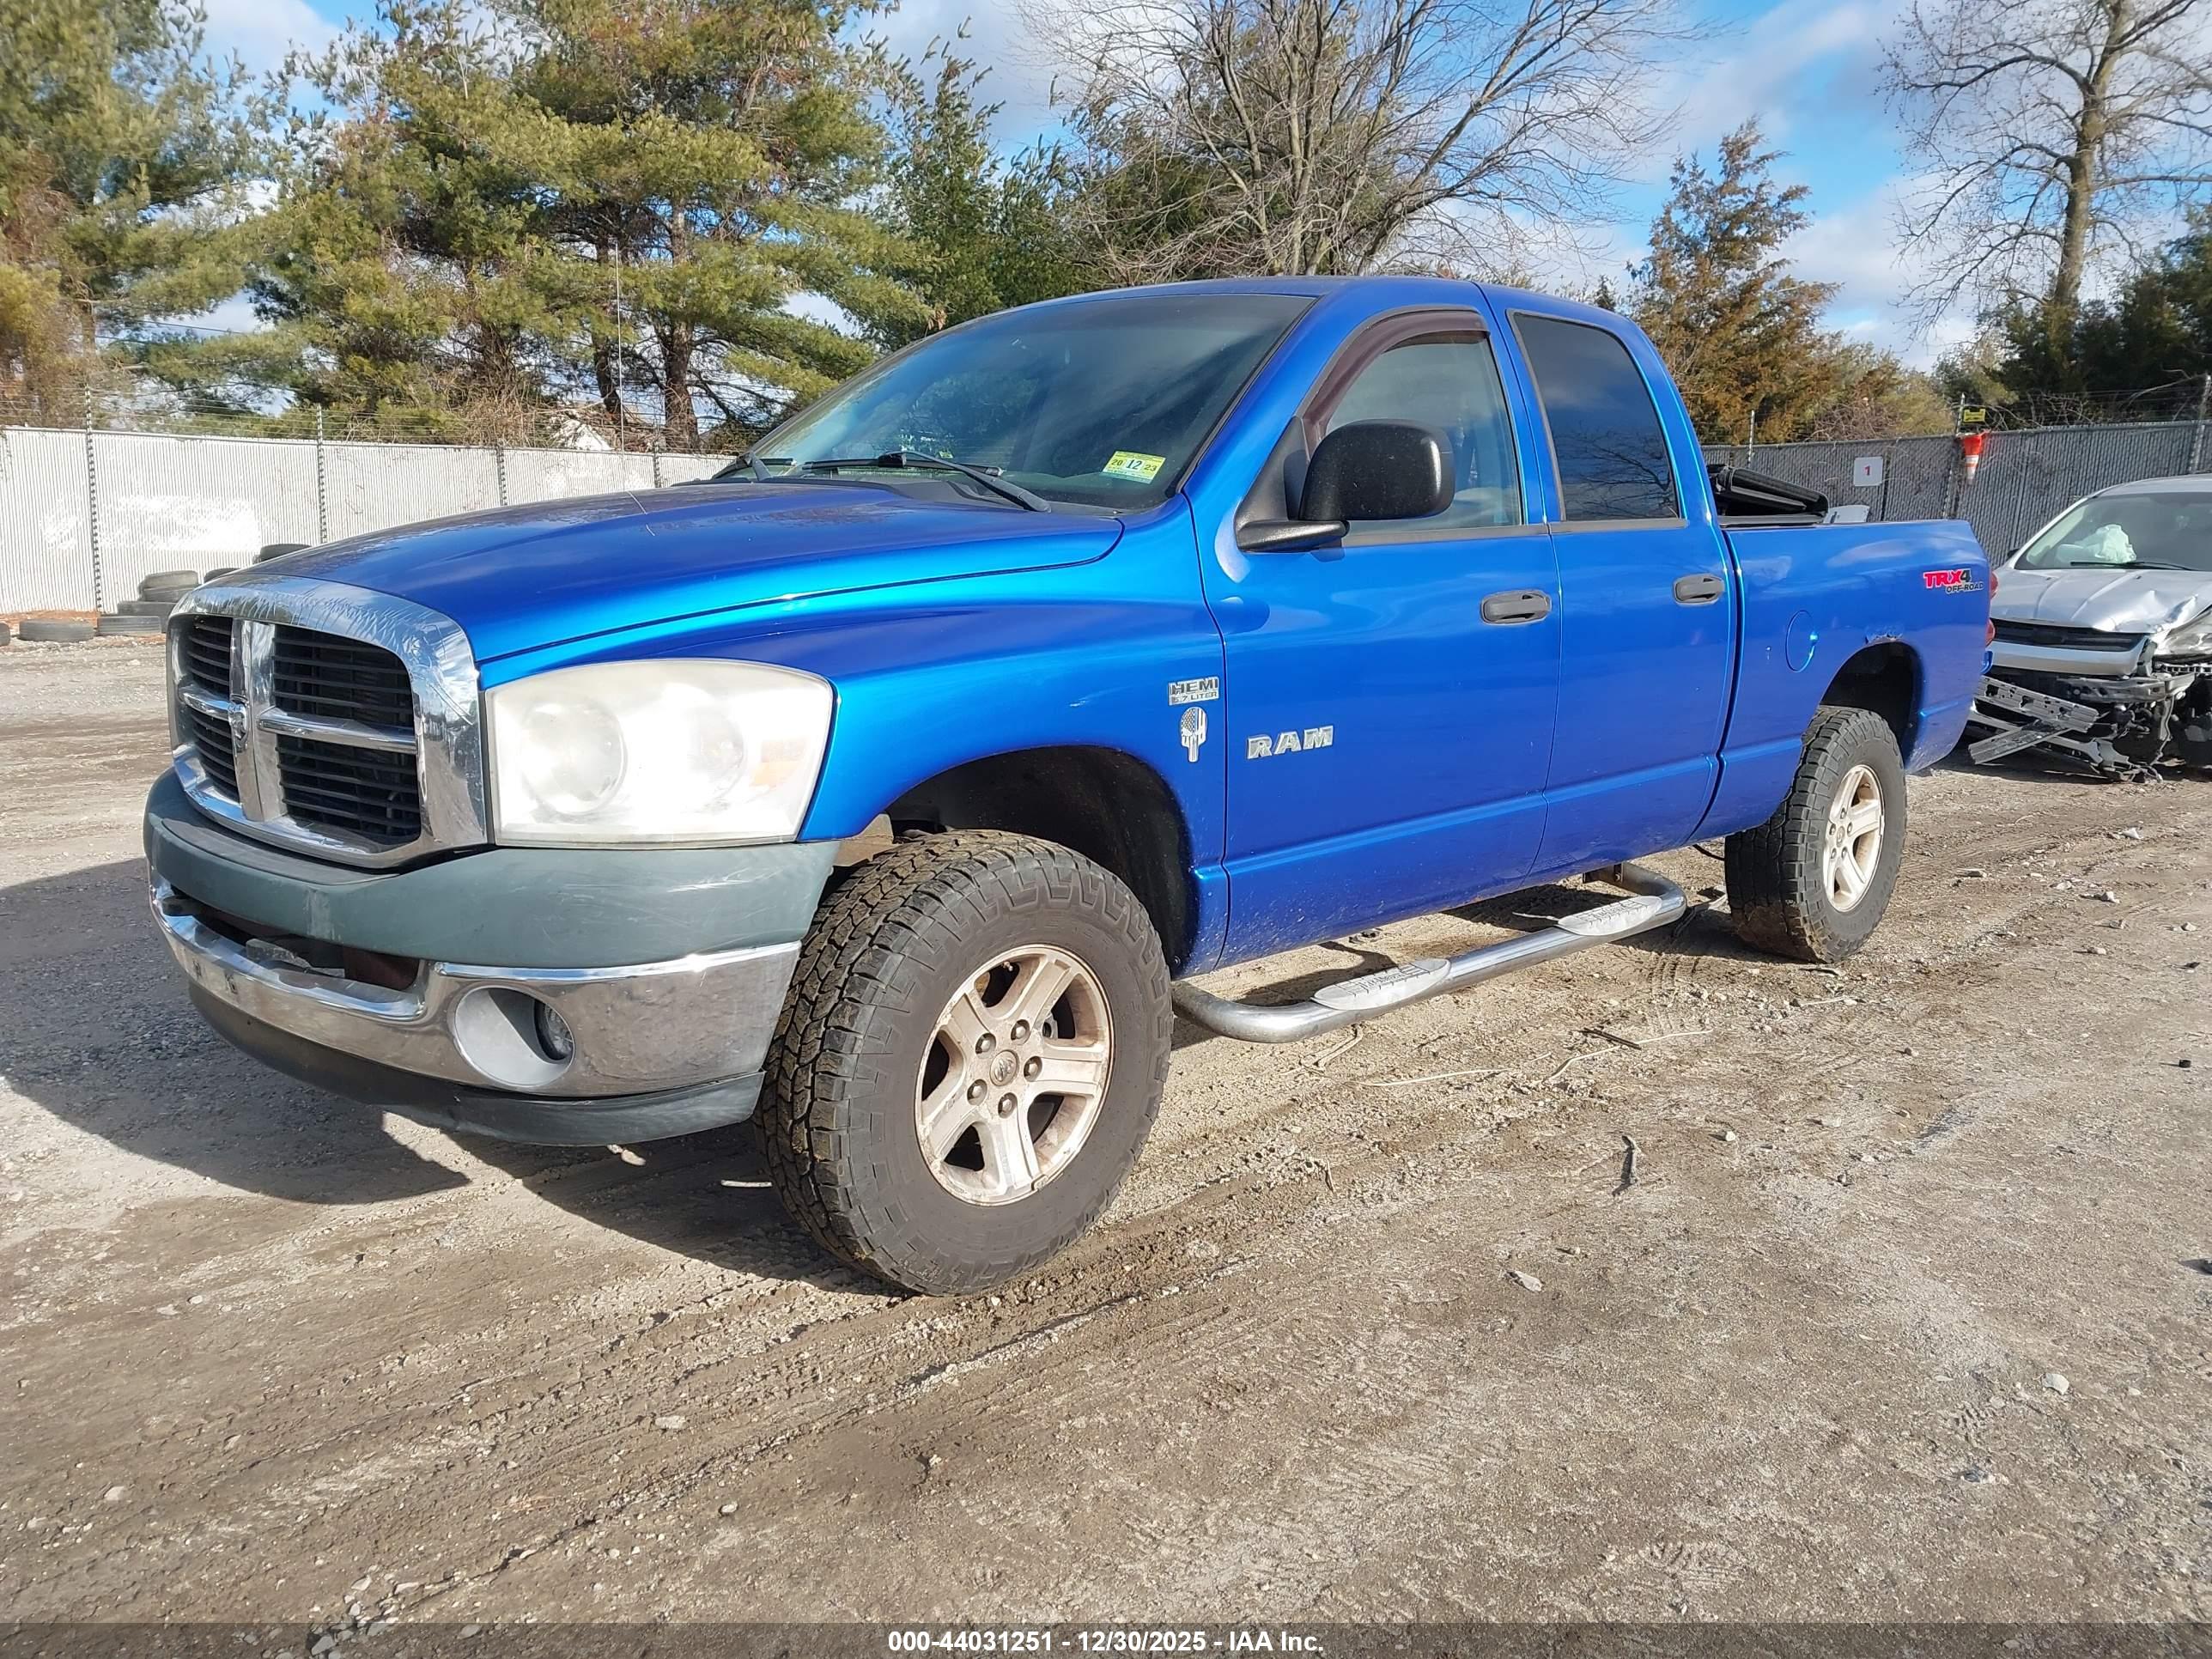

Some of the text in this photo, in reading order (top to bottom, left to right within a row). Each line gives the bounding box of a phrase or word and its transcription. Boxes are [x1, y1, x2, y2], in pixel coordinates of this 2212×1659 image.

[1126, 459, 1143, 471] 12
[1864, 465, 1870, 477] 1
[1923, 568, 1972, 589] TRX4
[1946, 582, 1984, 594] OFF-ROAD
[1171, 678, 1218, 695] HEMI
[1190, 691, 1217, 701] LITER
[1247, 726, 1334, 759] RAM
